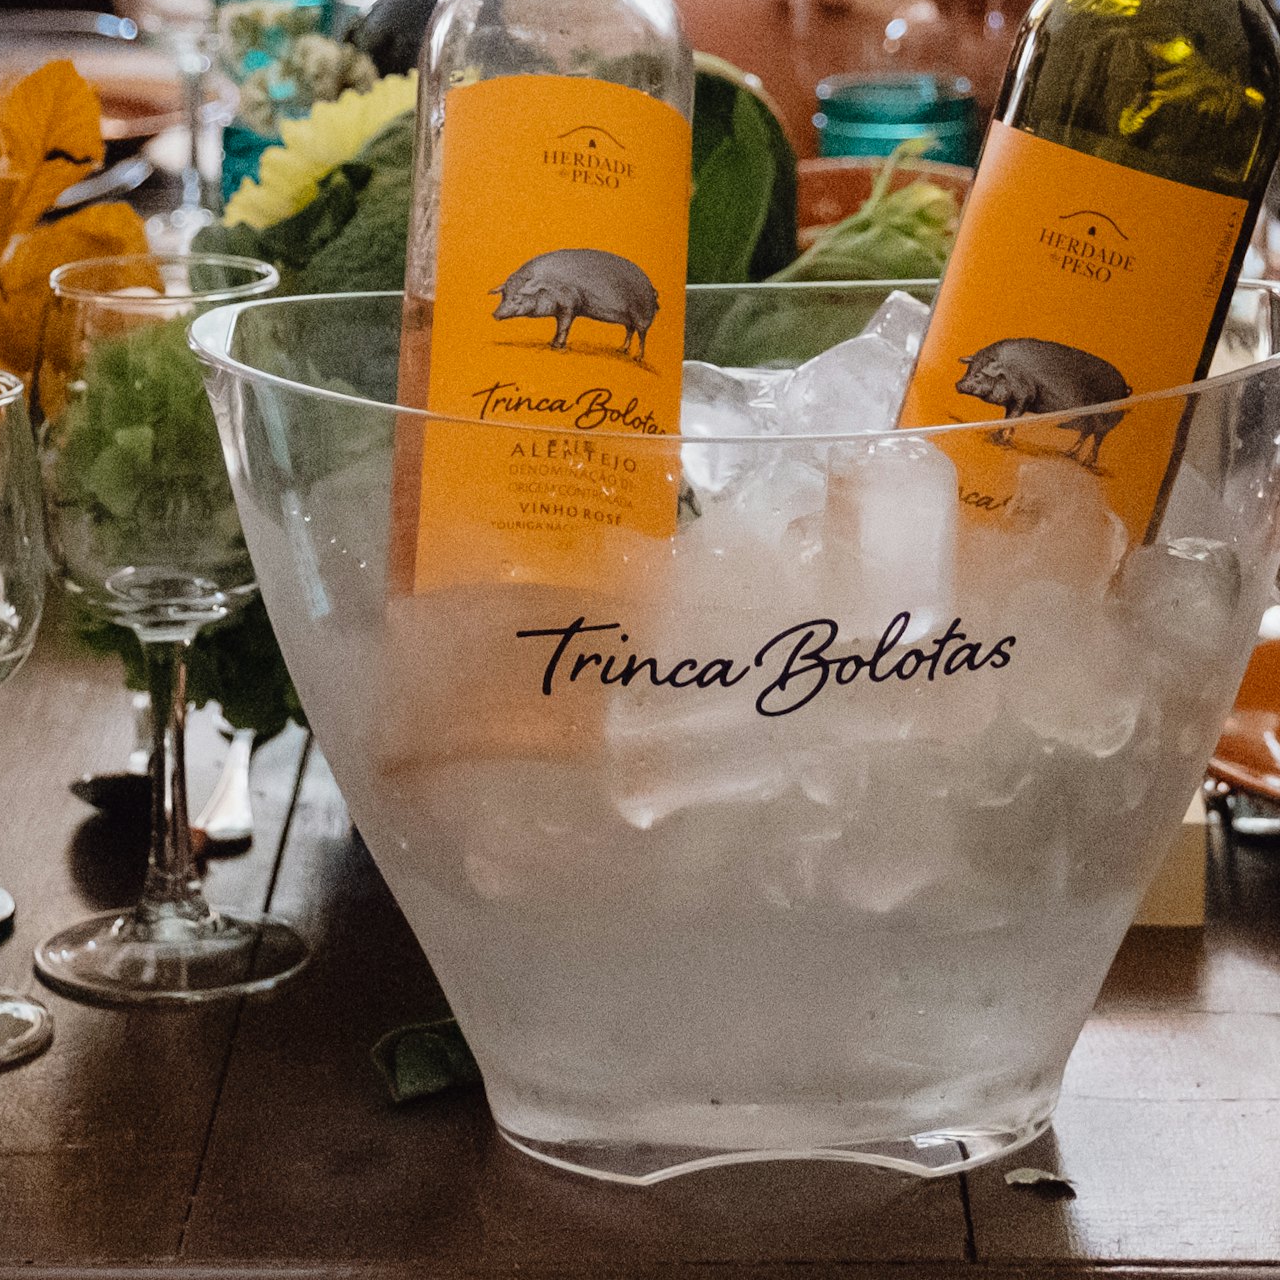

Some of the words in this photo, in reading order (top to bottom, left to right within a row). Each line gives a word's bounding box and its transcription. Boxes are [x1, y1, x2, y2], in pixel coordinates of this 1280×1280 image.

[543, 150, 635, 177] HERDADE
[571, 169, 620, 189] PESO
[1039, 227, 1137, 273] HERDADE
[1061, 255, 1112, 283] PESO
[472, 381, 574, 420] Trinca
[519, 502, 579, 518] VINHO
[516, 616, 753, 696] Trinca
[753, 610, 1017, 718] Bolotas
